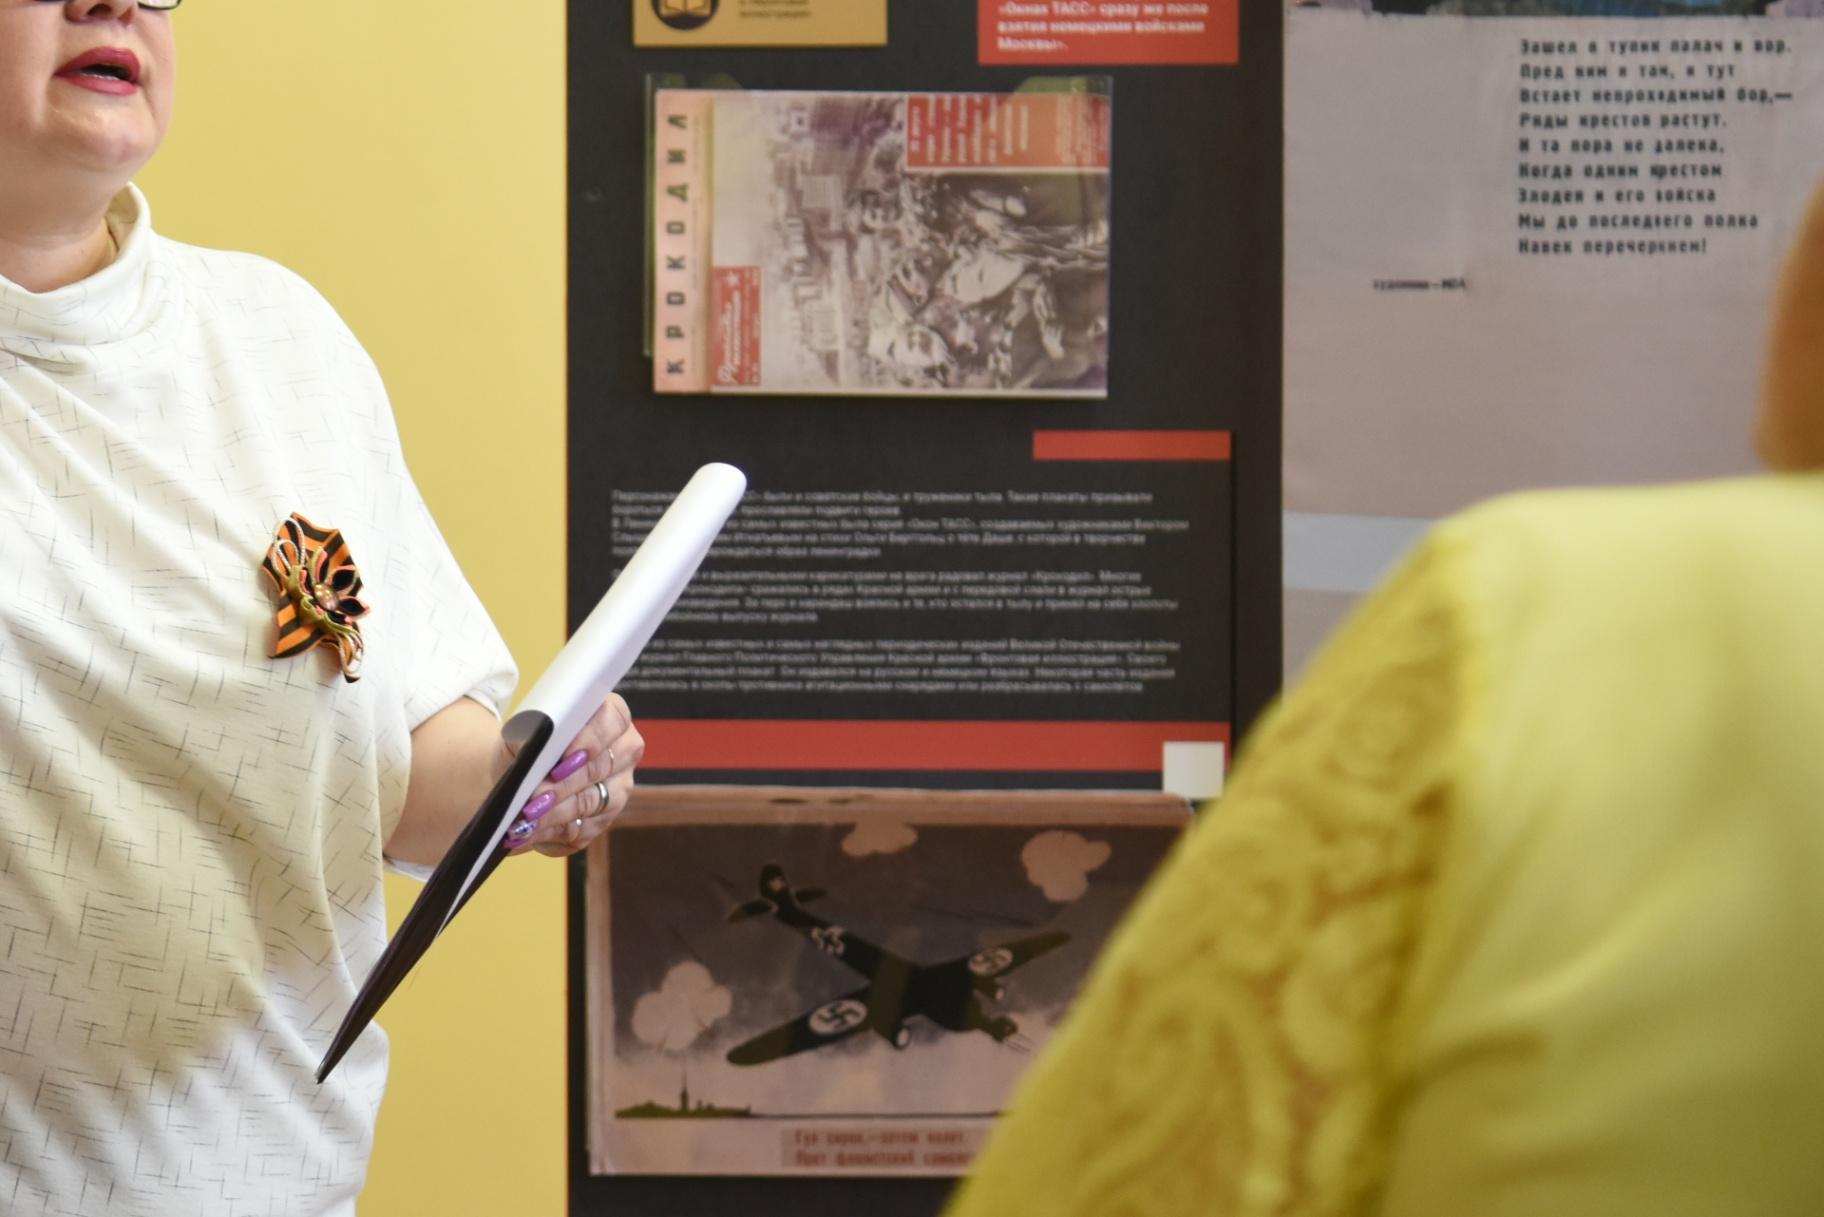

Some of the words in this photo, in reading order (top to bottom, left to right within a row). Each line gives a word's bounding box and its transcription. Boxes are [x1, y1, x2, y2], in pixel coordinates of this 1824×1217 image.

[1520, 39, 1577, 55] Зашел
[1609, 40, 1661, 57] тупик
[1671, 40, 1723, 53] палач
[1754, 40, 1792, 56] вор.
[1520, 63, 1564, 81] Пред
[1576, 65, 1606, 77] ним
[1706, 64, 1735, 81] тут
[1520, 88, 1581, 103] Встает
[1592, 87, 1726, 106] непроходимый
[1520, 113, 1568, 129] Ряды
[1579, 114, 1650, 131] крестов
[1661, 114, 1727, 131] растут.
[1542, 139, 1559, 152] та
[1571, 139, 1613, 155] пора
[1624, 139, 1644, 152] не
[1519, 162, 1574, 179] Когда
[1584, 164, 1639, 179] одним
[1650, 163, 1722, 181] крестом
[1616, 189, 1644, 202] его
[1655, 187, 1715, 202] войска
[1519, 213, 1545, 229] Мы
[1557, 214, 1578, 230] до
[1589, 213, 1692, 230] последнего
[1704, 214, 1758, 227] полка
[666, 112, 688, 375] КРОКОДИЛ
[1519, 239, 1572, 254] Навек
[1583, 238, 1707, 256] перечеркнем!
